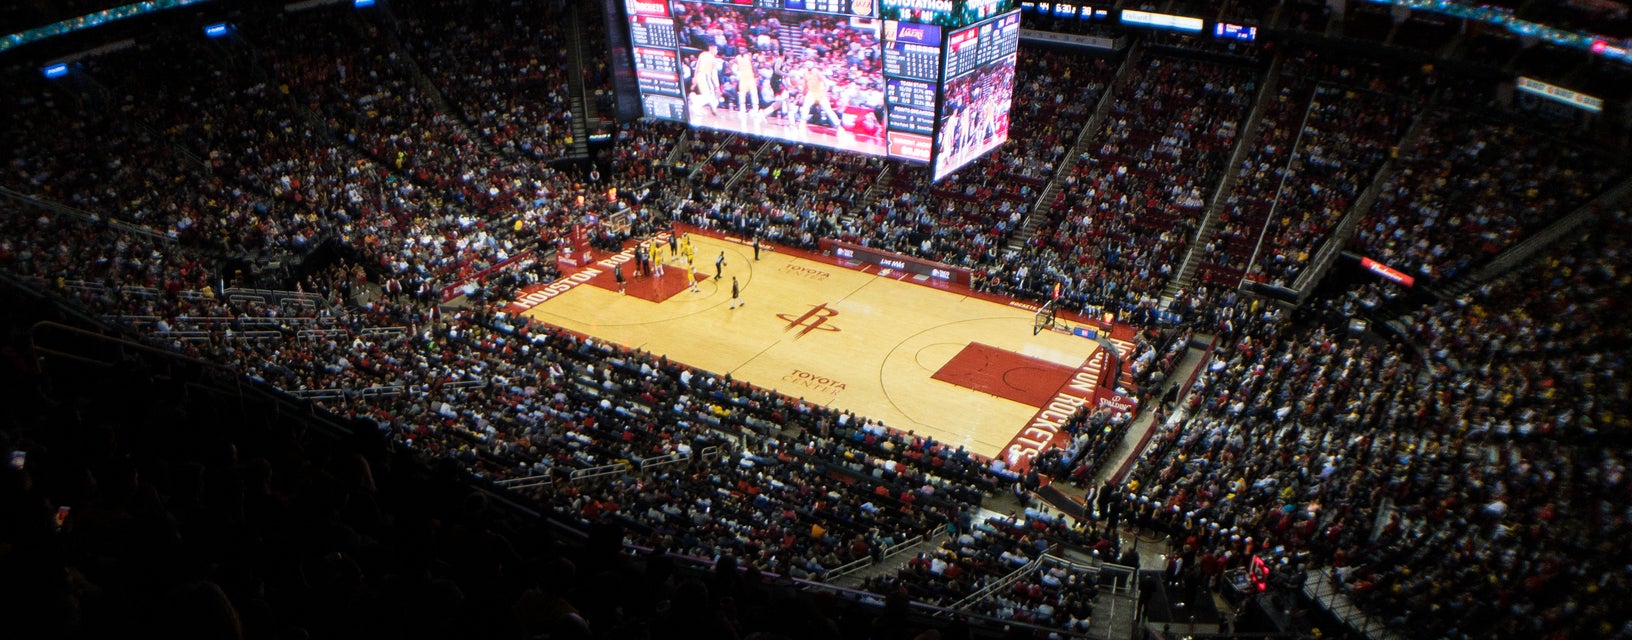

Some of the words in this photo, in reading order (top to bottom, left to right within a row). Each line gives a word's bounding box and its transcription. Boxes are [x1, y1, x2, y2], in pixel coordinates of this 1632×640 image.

[786, 264, 830, 278] TOYOTA
[513, 267, 603, 310] HOUSTON
[791, 369, 846, 390] TOYOTA
[1009, 392, 1090, 460] ROCKETS
